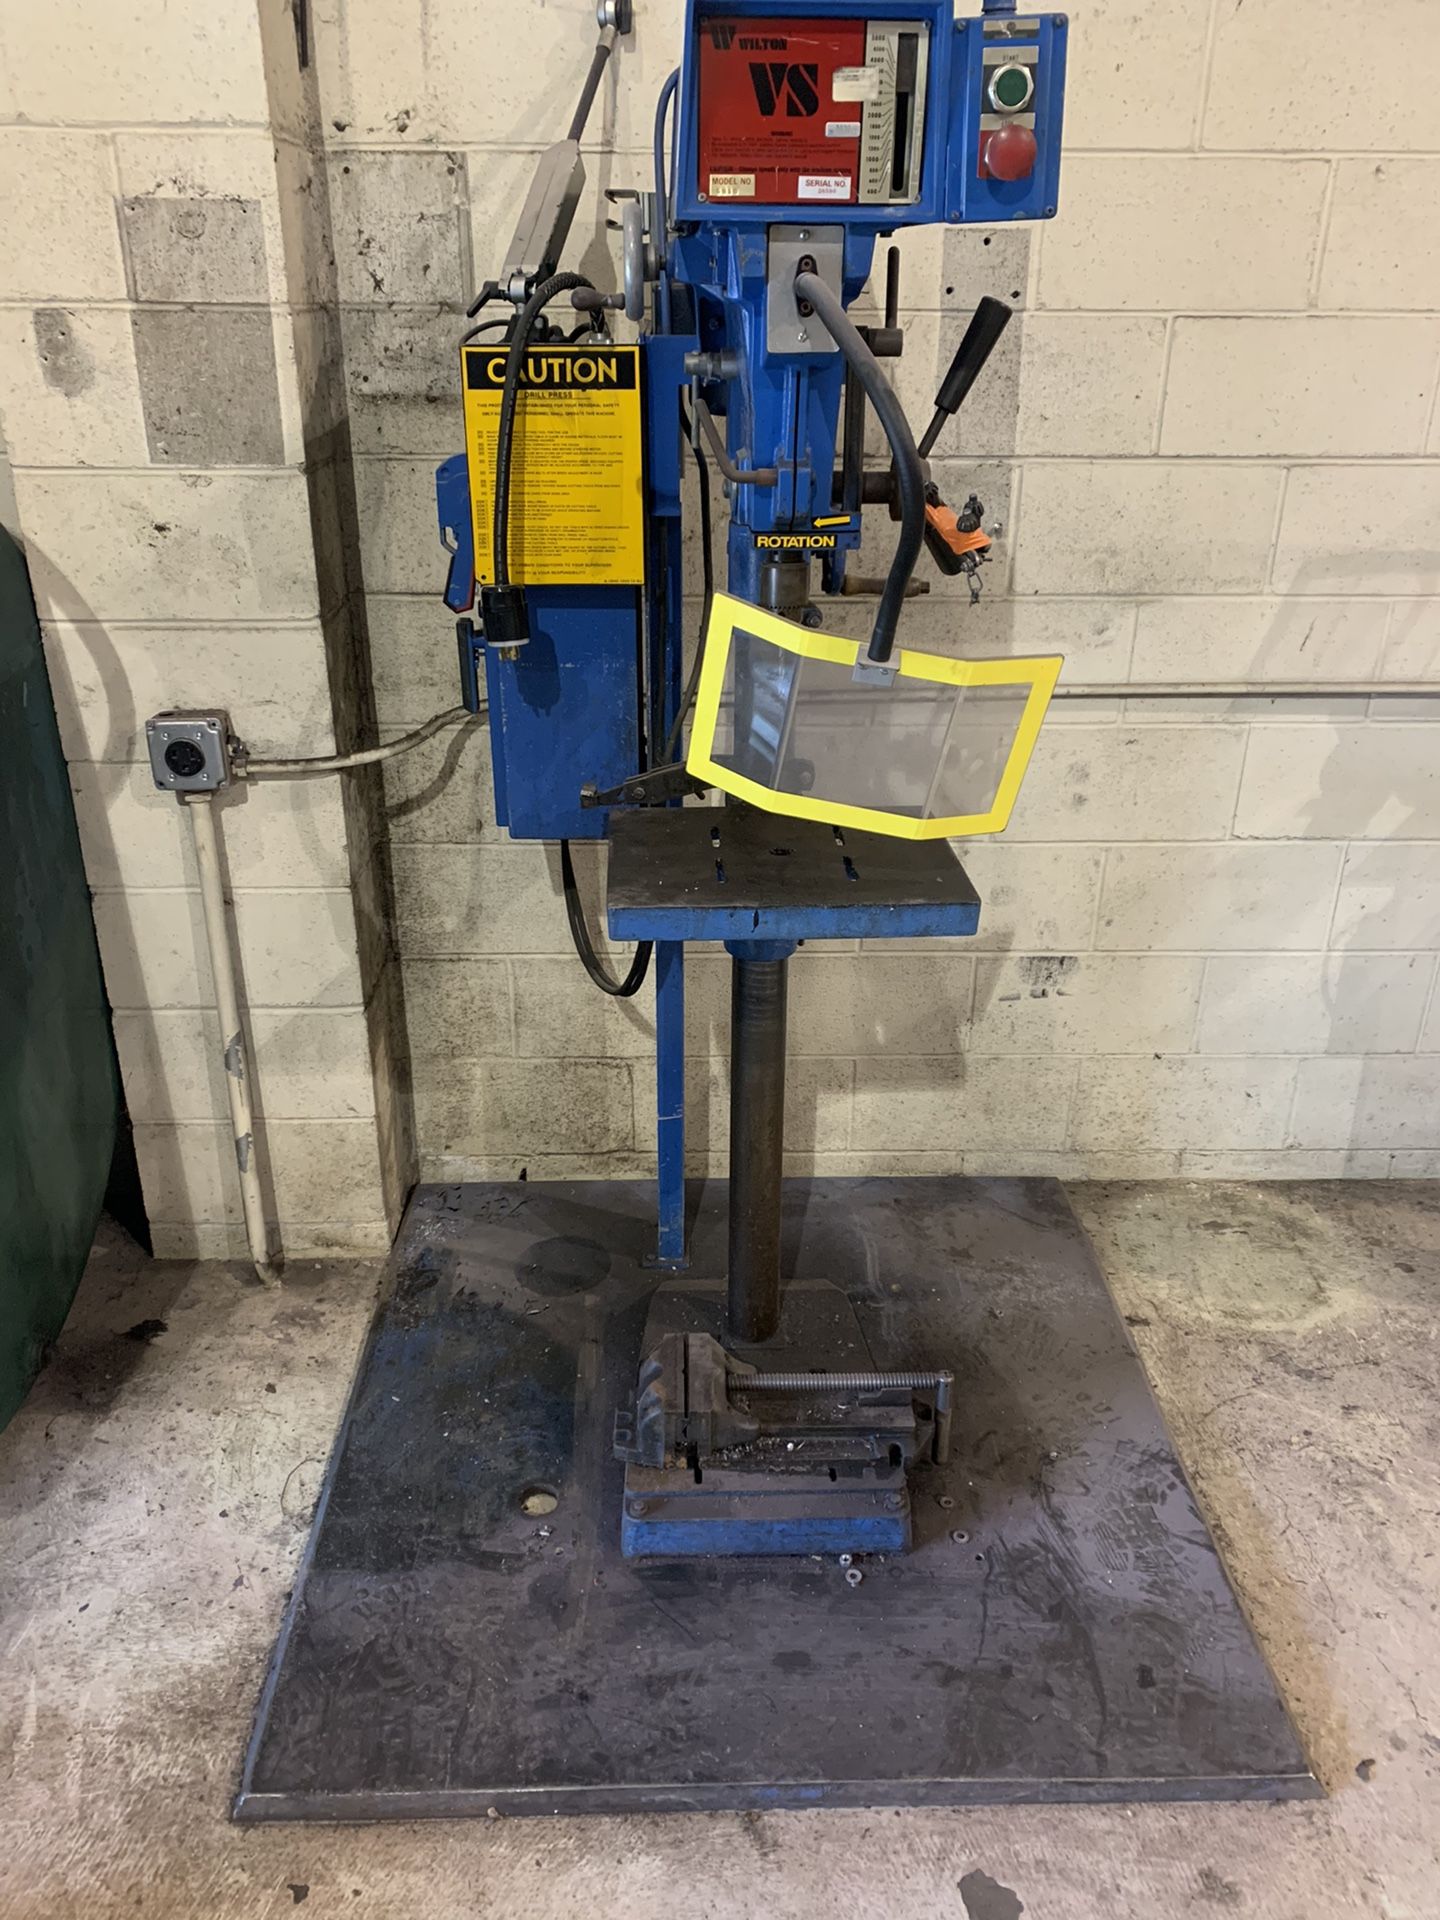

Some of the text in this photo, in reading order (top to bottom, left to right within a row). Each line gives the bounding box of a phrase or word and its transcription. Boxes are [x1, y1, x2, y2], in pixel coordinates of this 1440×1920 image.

[738, 38, 788, 51] WILTON
[749, 62, 819, 117] VS
[712, 177, 737, 185] MODEL
[805, 179, 831, 187] SERIAL
[487, 358, 617, 383] CUTION
[524, 391, 573, 399] DRILL PRESS
[757, 535, 835, 547] ROTATION
